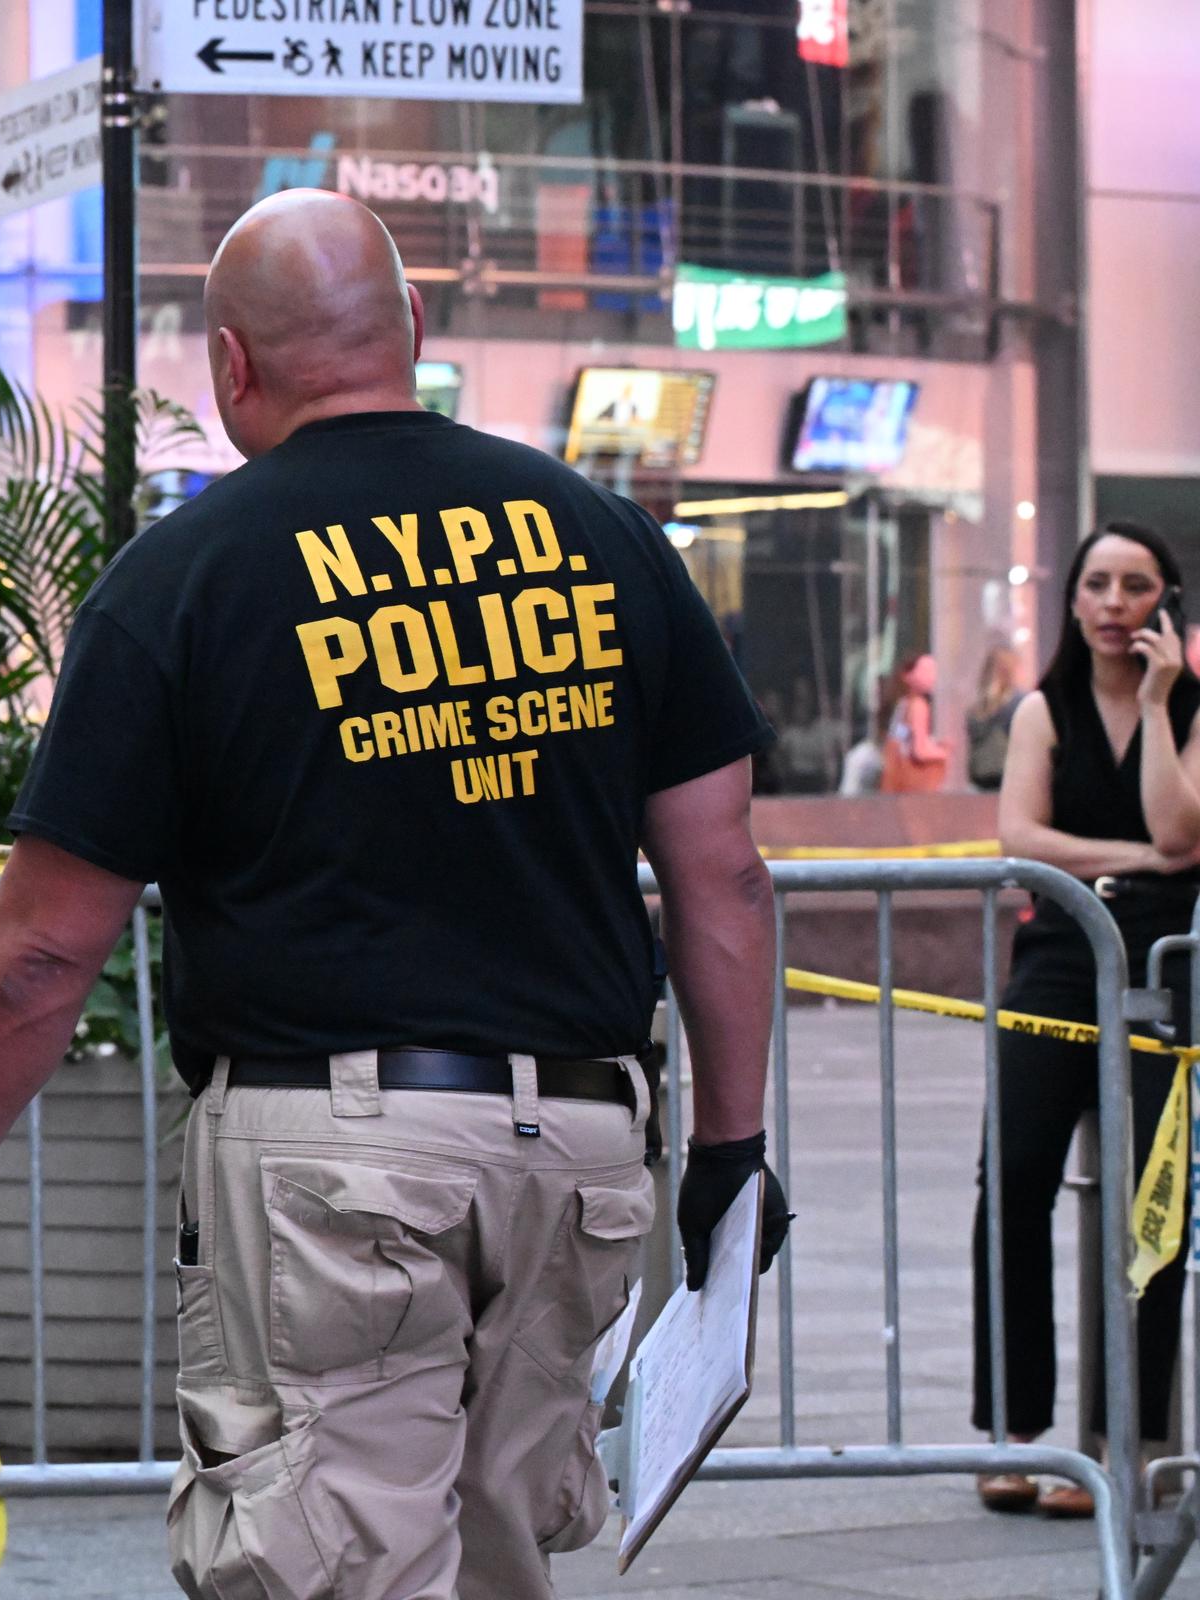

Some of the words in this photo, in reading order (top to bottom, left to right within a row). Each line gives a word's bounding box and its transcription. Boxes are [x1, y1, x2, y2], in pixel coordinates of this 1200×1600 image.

[193, 0, 380, 23] PEDESTRIAN
[393, 0, 471, 26] FLOW
[484, 0, 560, 30] ZONE
[361, 40, 435, 79] KEEP
[447, 43, 562, 83] MOVING
[295, 500, 588, 604] N.Y.P.D.
[295, 582, 624, 711] POLICE
[338, 700, 477, 764] CRIME
[485, 681, 616, 742] SCENE
[451, 749, 540, 805] UNIT
